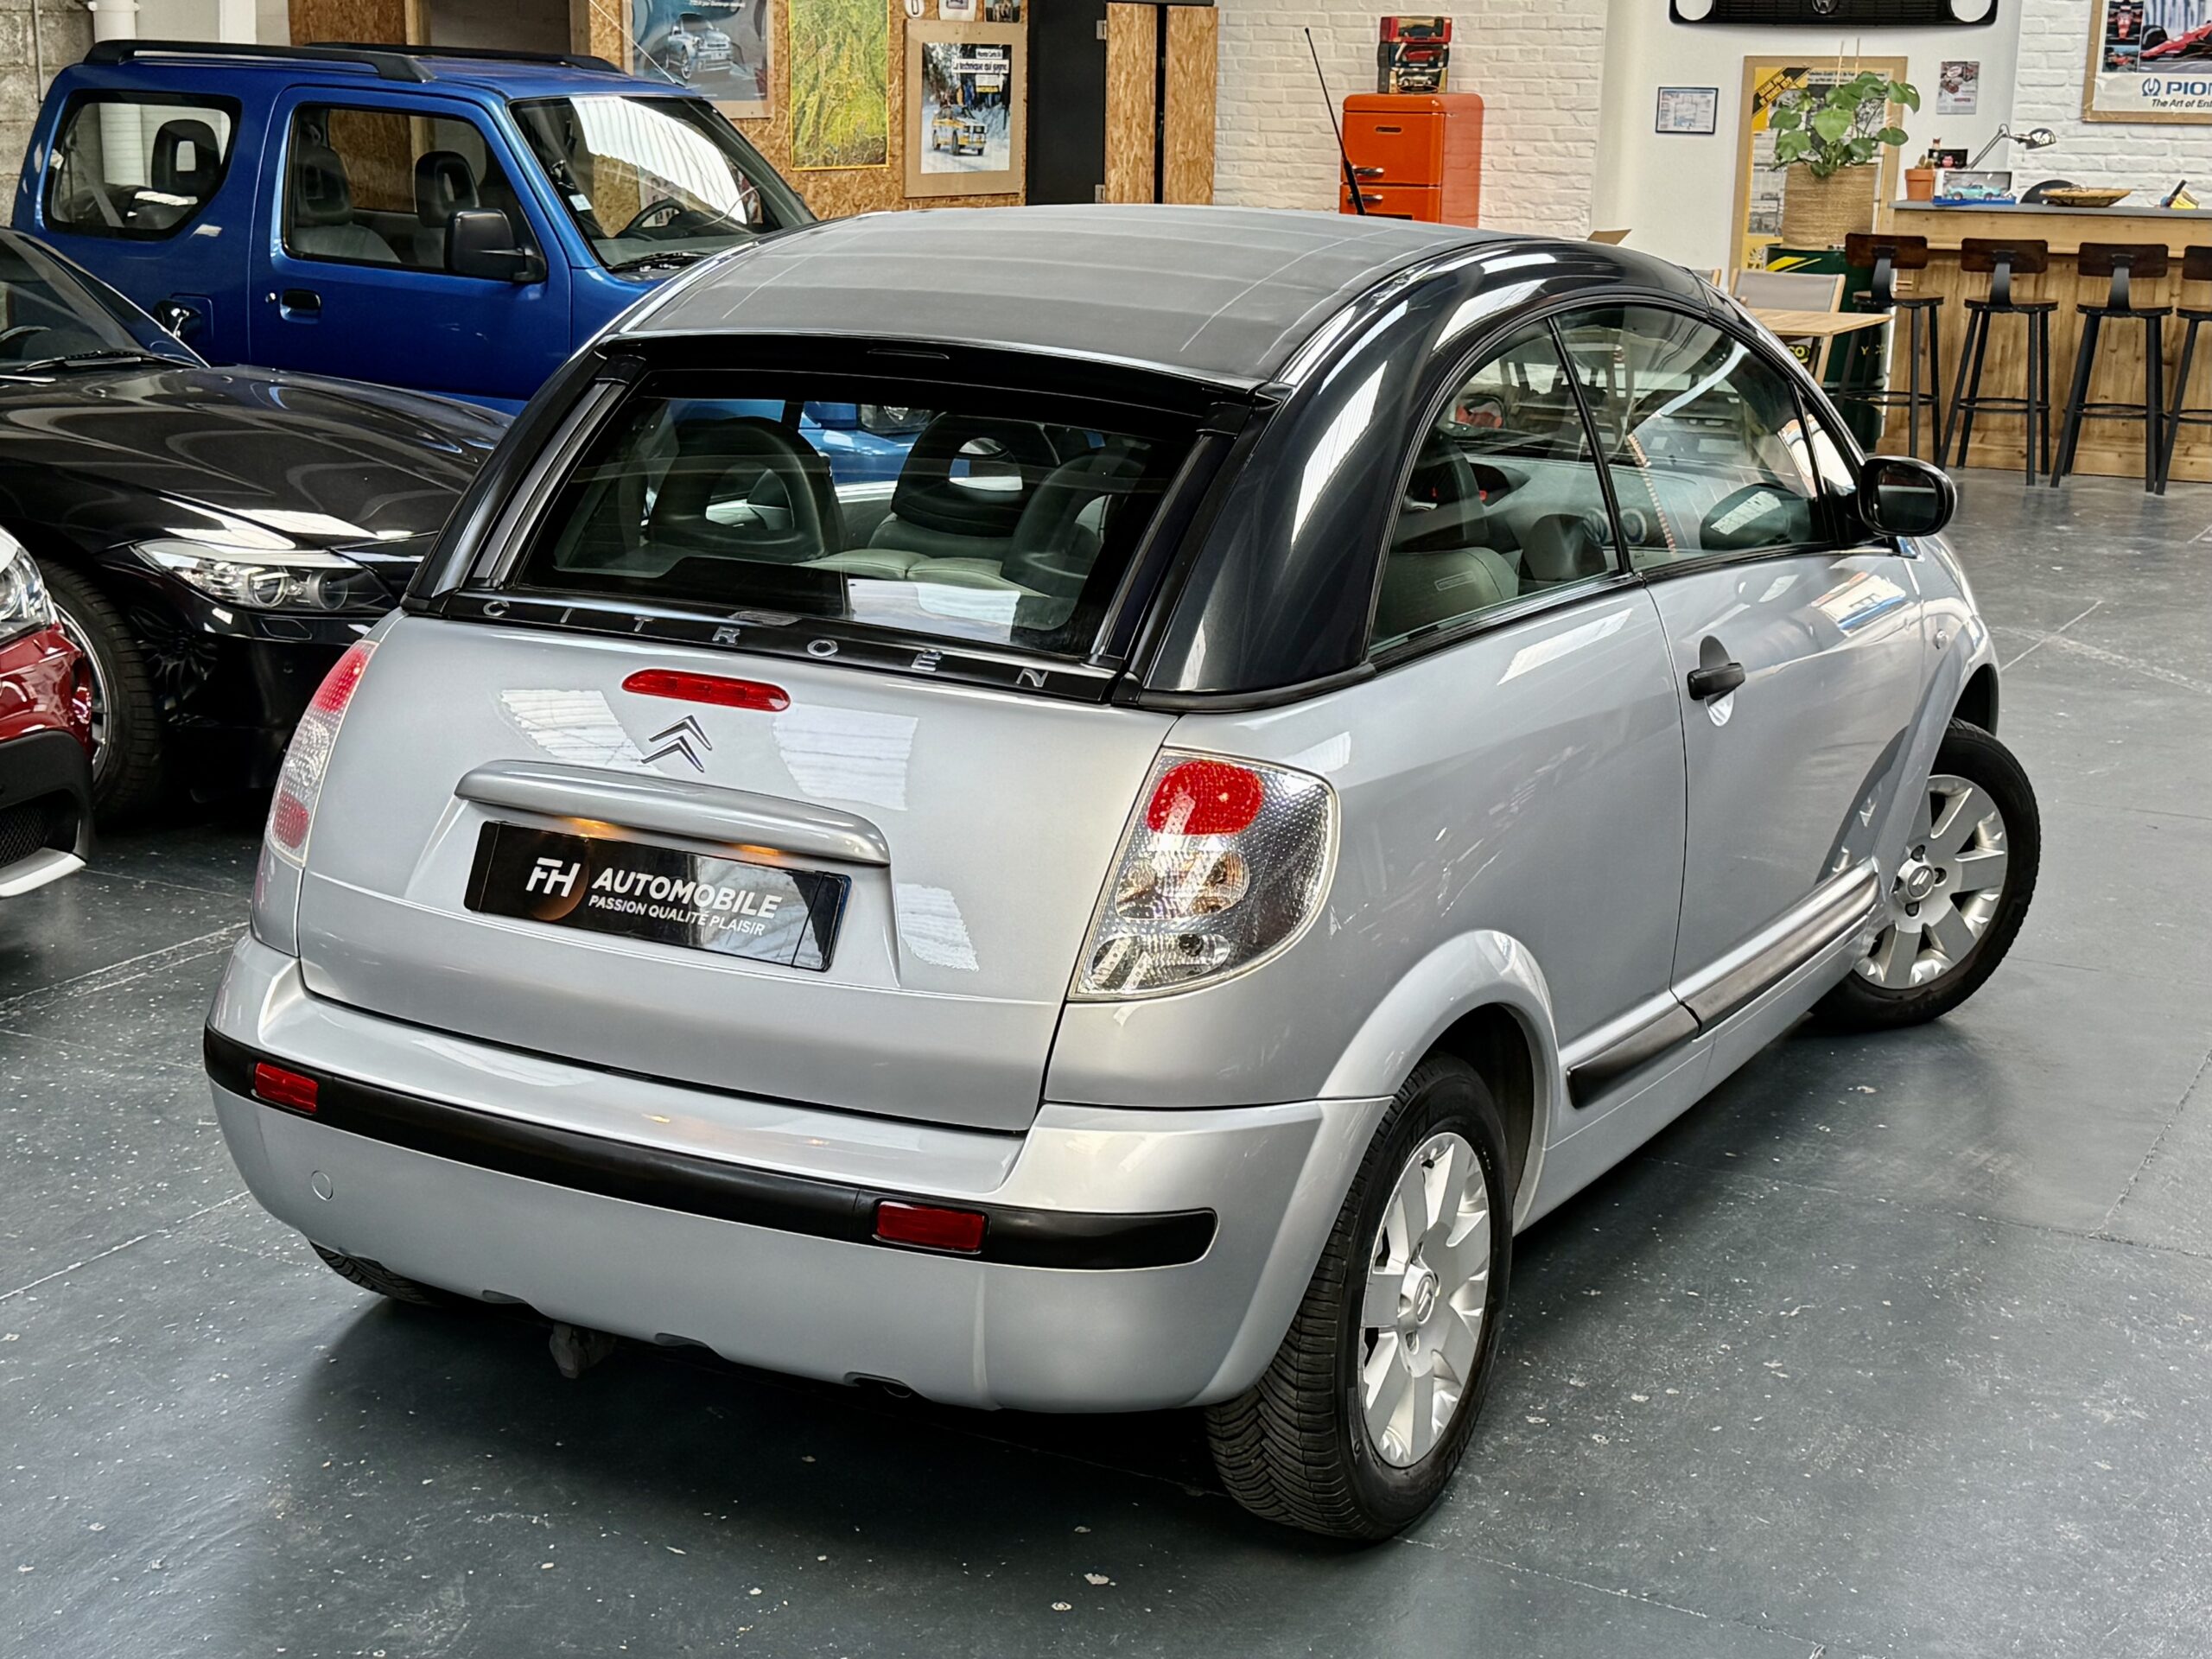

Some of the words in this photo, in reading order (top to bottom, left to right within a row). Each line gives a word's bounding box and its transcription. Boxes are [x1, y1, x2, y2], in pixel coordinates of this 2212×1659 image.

[2165, 81, 2212, 95] PIO
[525, 857, 581, 898] FH
[591, 868, 783, 919] AUTOMOBILE
[588, 895, 647, 915] PASSION
[648, 906, 709, 927] QUALITÉ
[709, 916, 766, 937] PLAISIR
